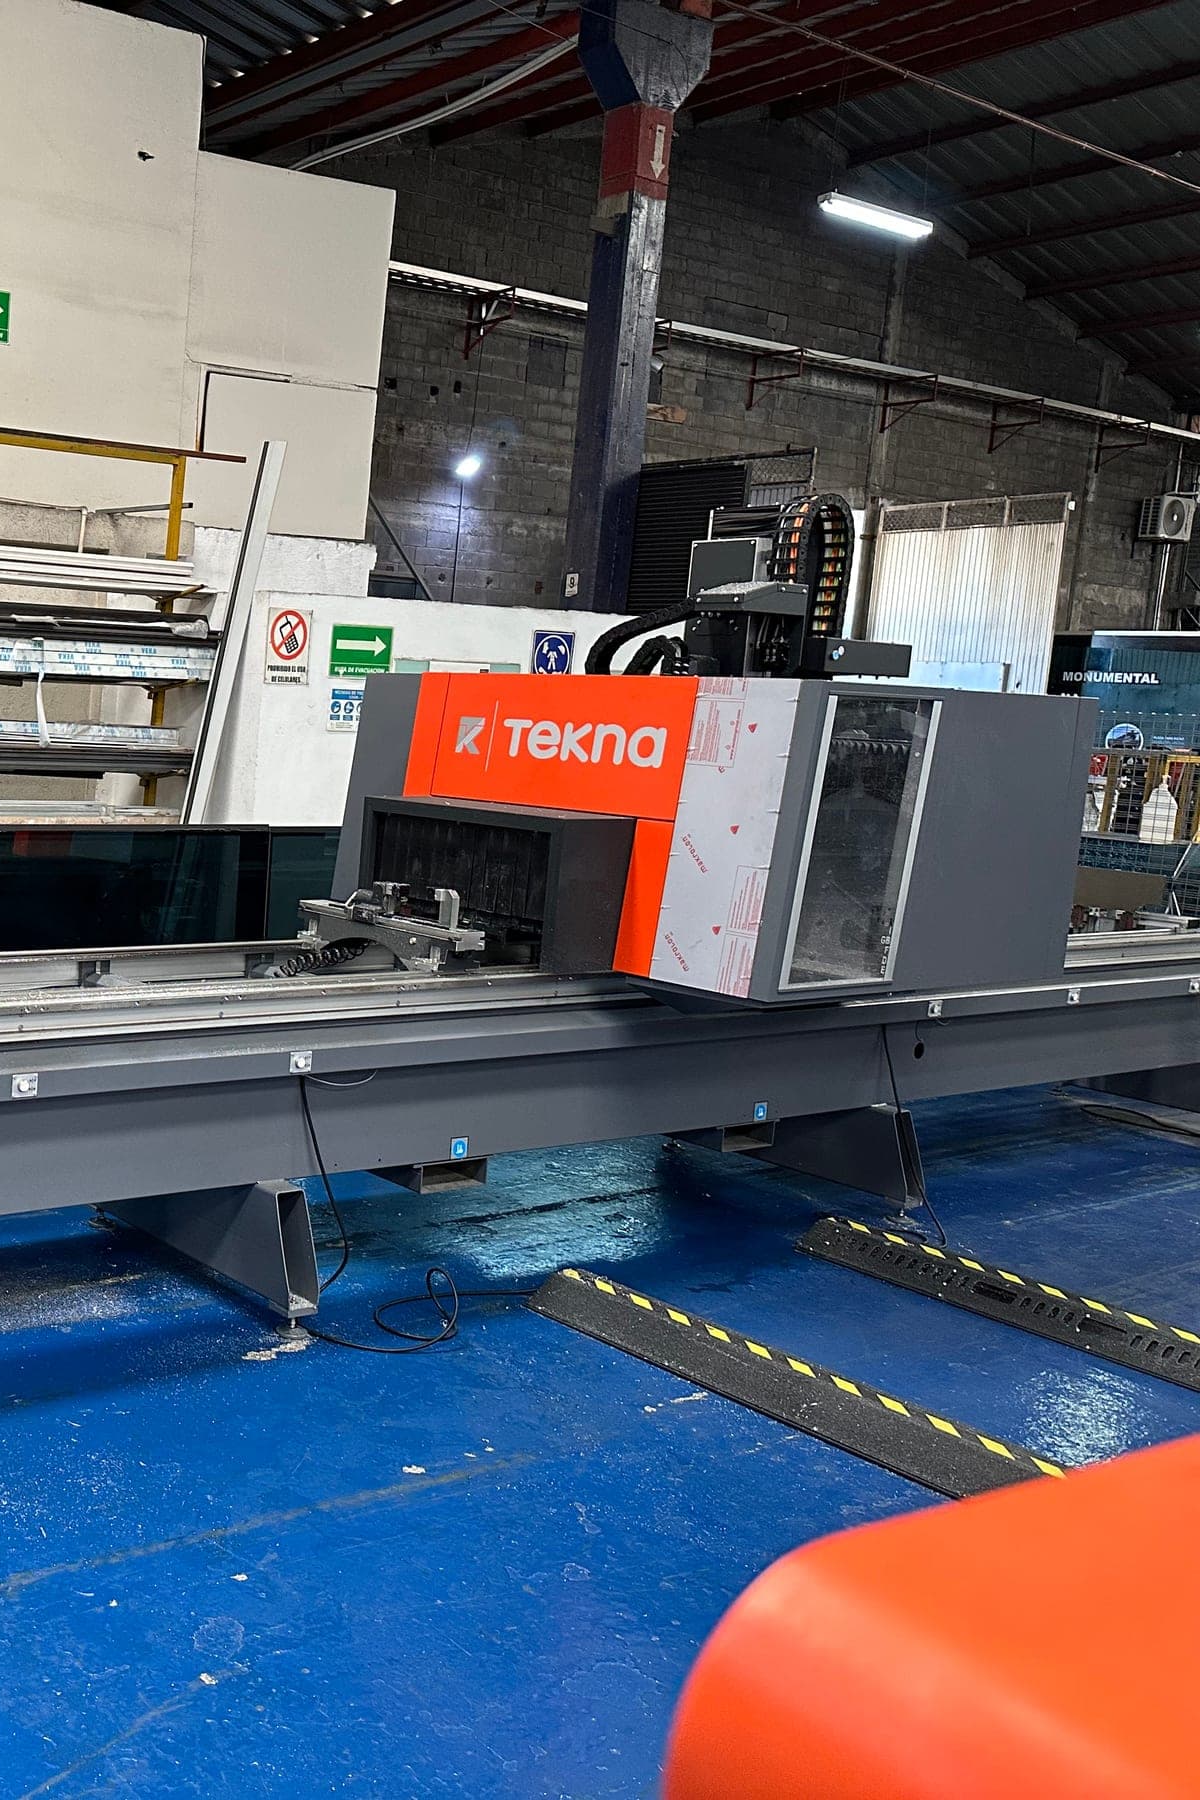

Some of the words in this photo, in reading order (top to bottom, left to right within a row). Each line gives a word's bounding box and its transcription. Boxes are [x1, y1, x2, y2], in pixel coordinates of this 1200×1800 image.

[1062, 671, 1159, 684] MONUMENTAL
[682, 835, 709, 874] makrolon
[665, 933, 689, 972] makrolon
